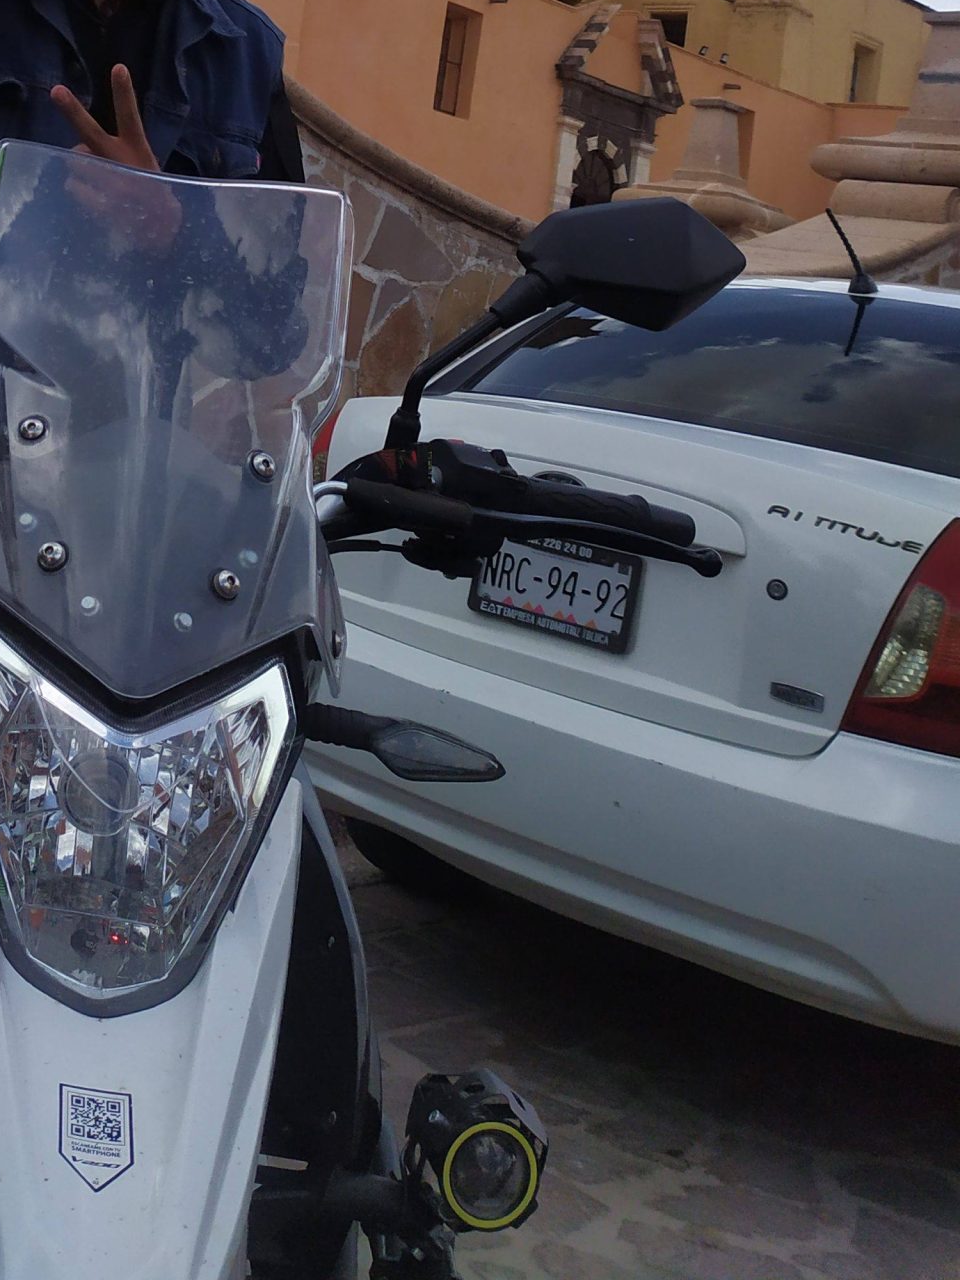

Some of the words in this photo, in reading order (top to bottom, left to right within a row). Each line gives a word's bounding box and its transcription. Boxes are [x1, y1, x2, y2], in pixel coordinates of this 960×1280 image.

[543, 537, 562, 551] 226
[563, 542, 578, 555] 24
[579, 546, 593, 559] 00
[482, 550, 630, 620] NRC-94-92
[503, 607, 536, 625] EMPRESA
[581, 627, 609, 645] TOLUCA
[71, 1145, 121, 1158] SMARTPHONE
